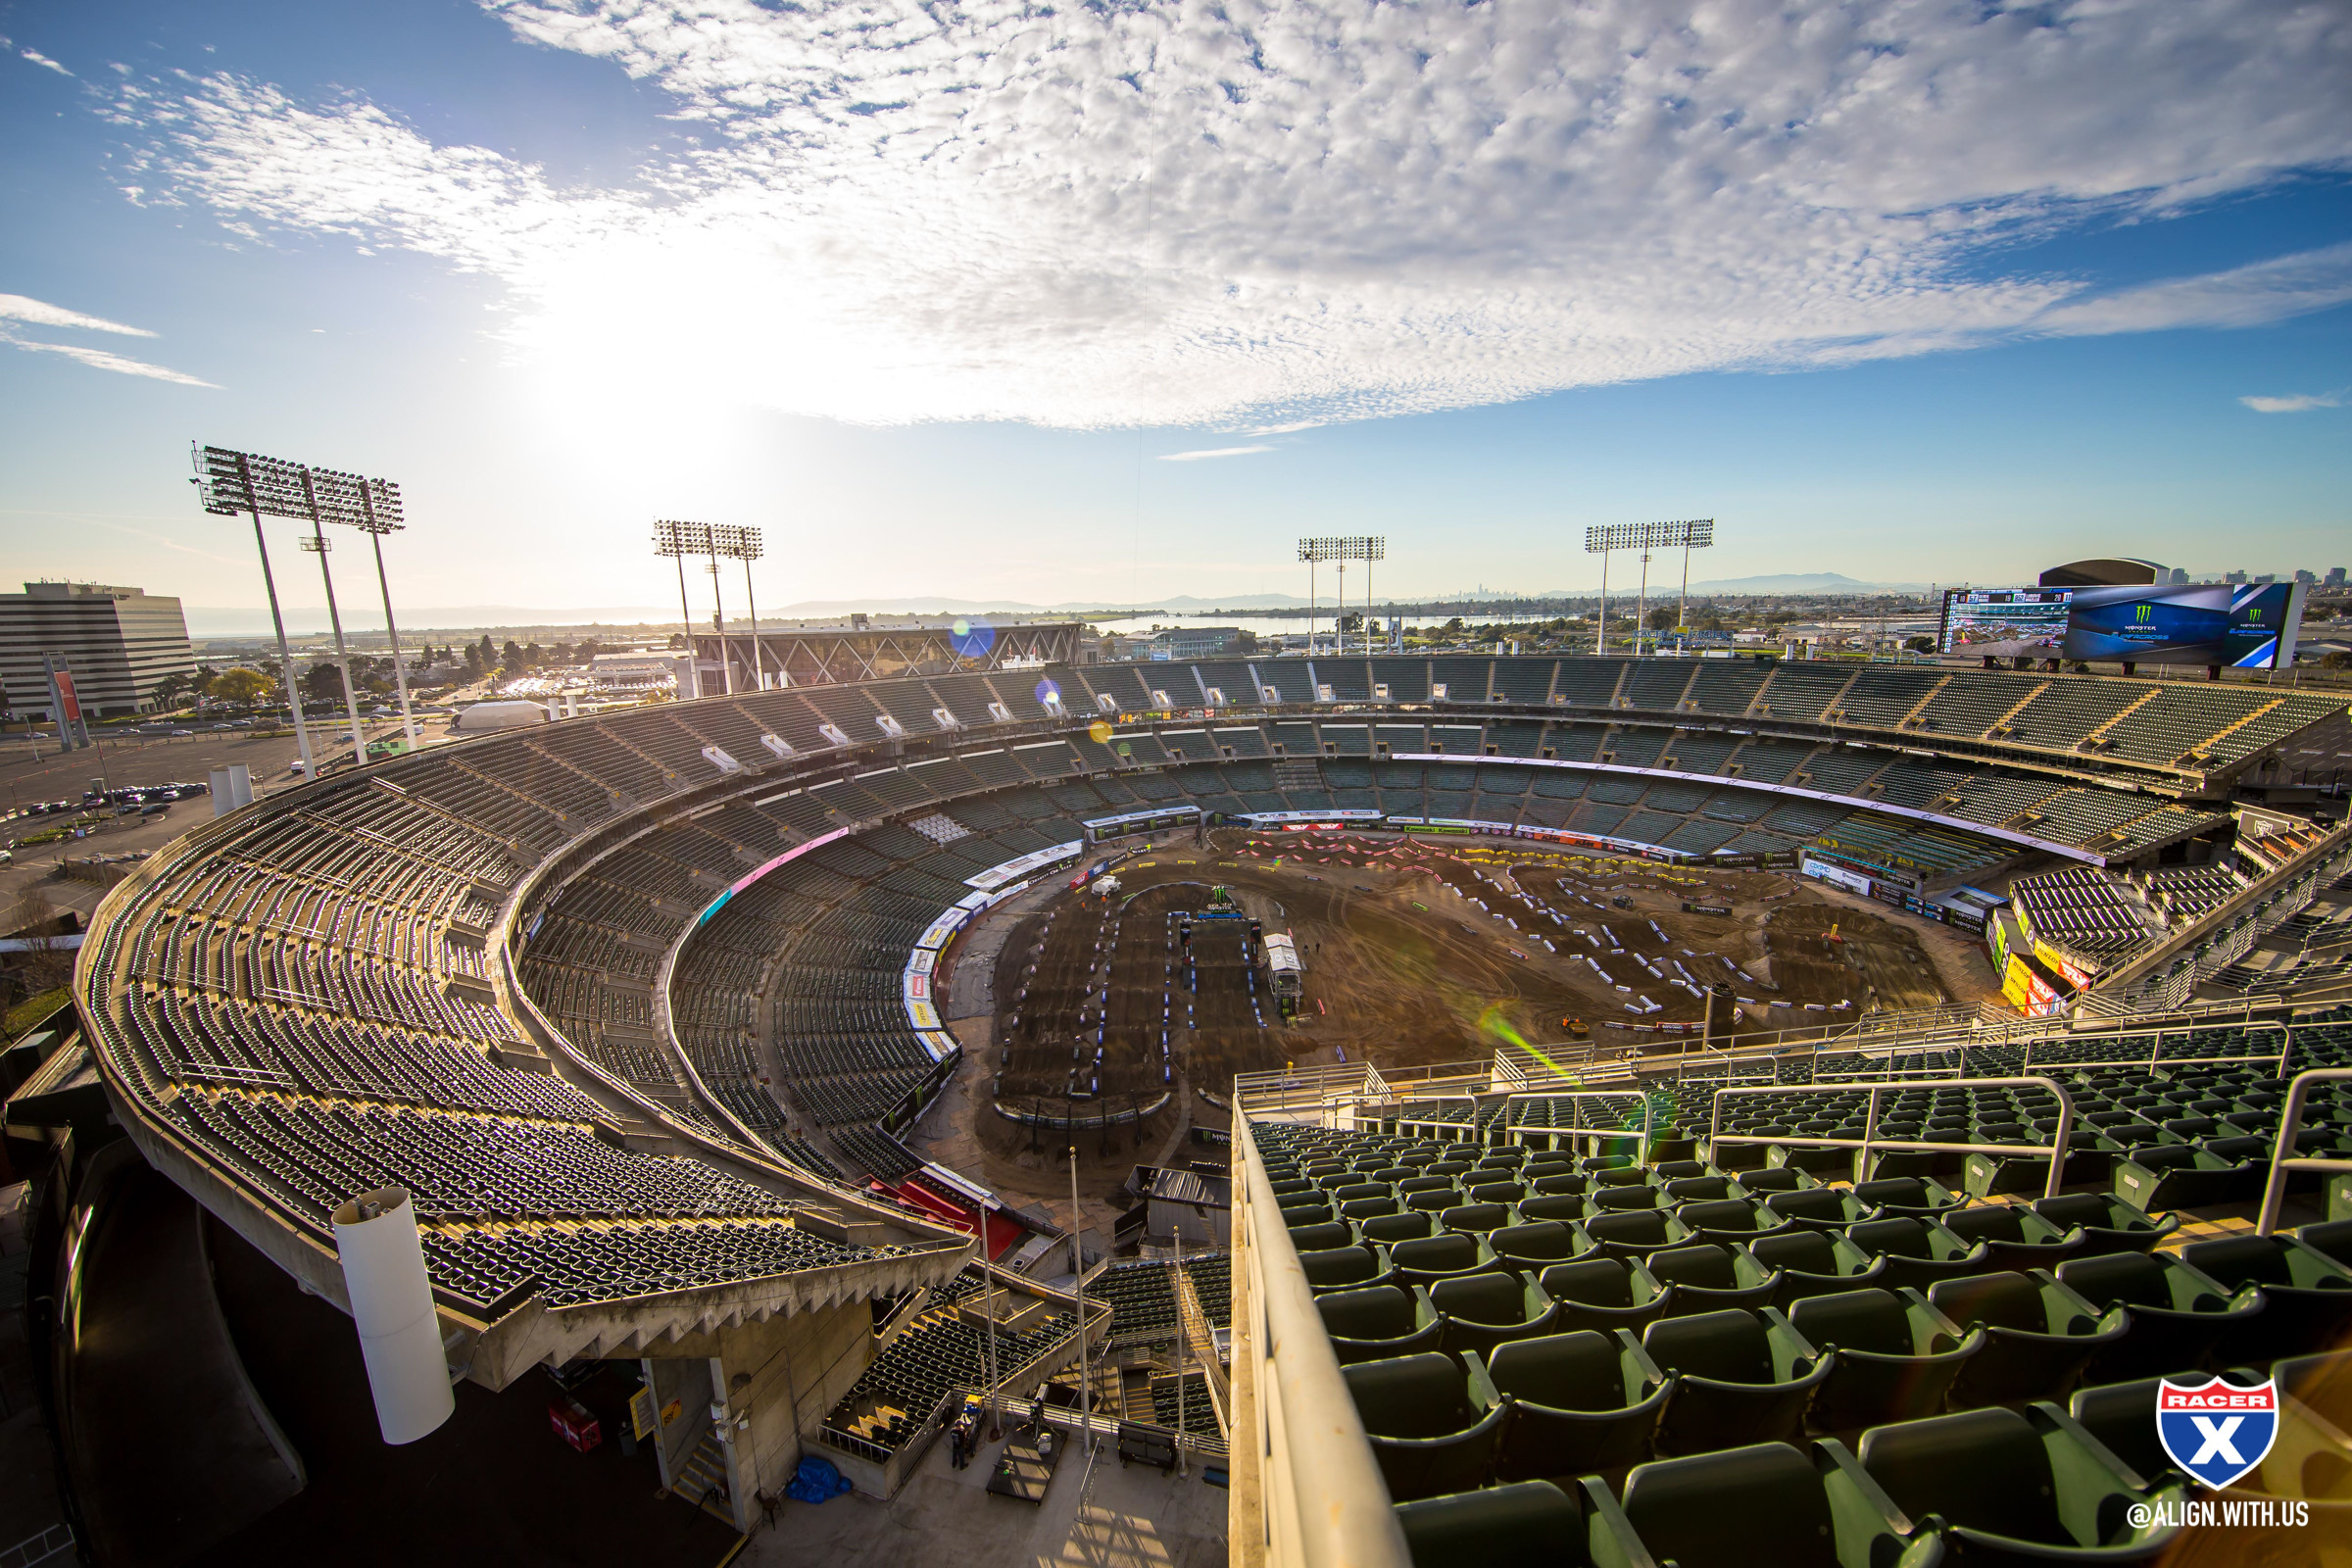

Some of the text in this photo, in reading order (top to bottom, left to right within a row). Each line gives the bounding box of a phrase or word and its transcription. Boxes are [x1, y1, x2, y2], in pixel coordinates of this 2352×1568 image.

[1955, 910, 1984, 923] MONSTER
[1954, 919, 1982, 932] MONSTER
[2037, 948, 2059, 965] DUNLOP
[2013, 961, 2031, 979] DUNLOP
